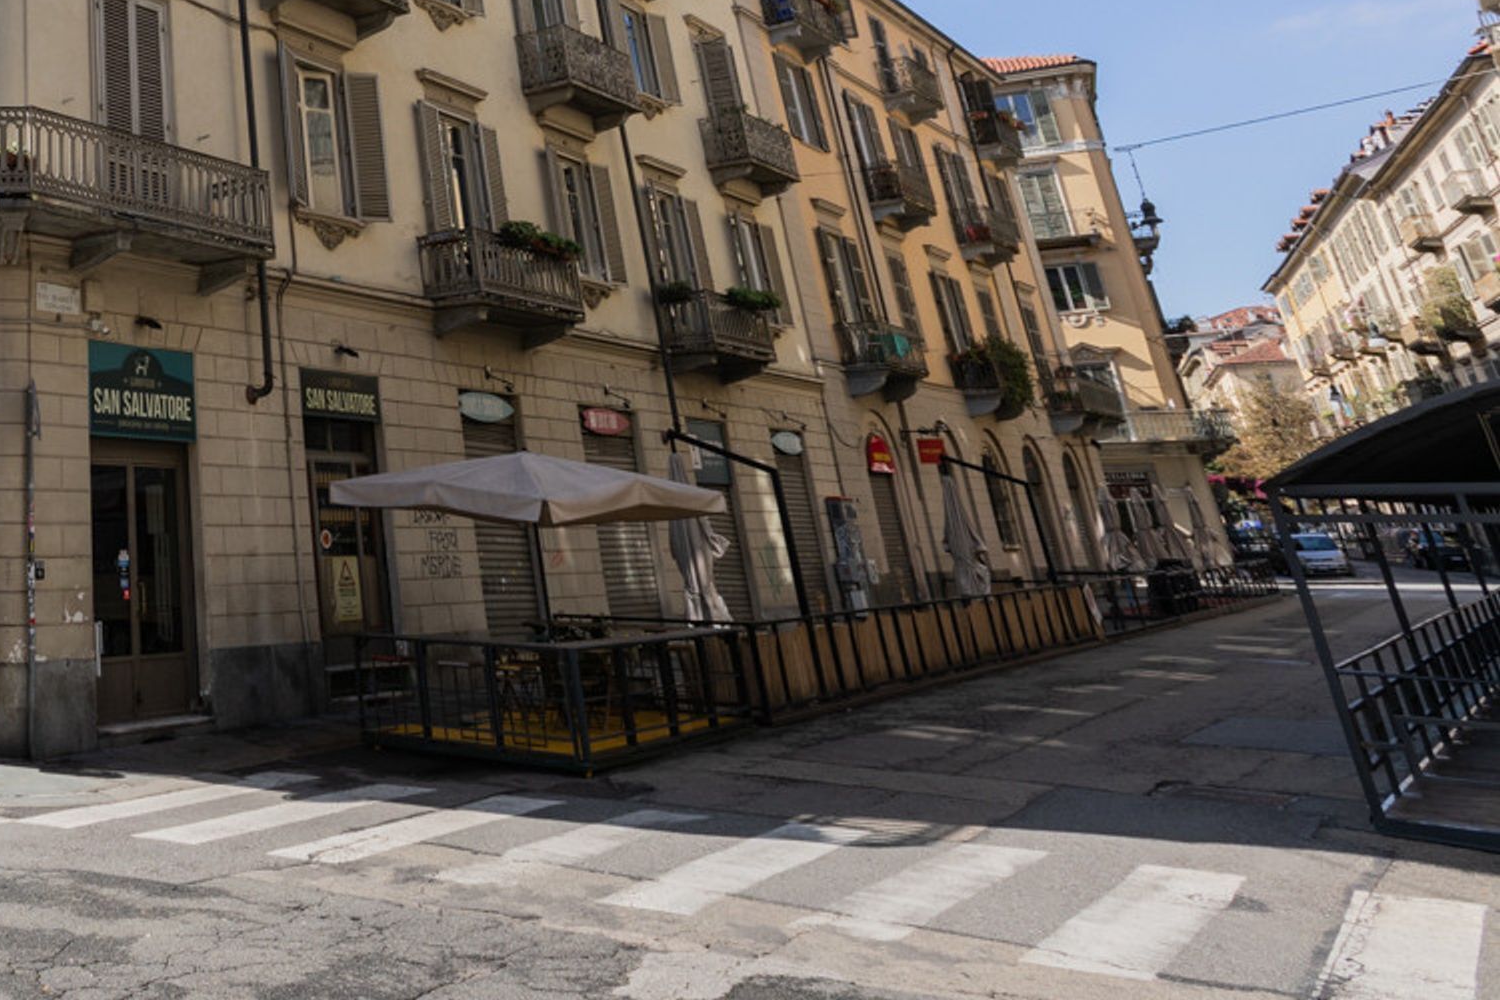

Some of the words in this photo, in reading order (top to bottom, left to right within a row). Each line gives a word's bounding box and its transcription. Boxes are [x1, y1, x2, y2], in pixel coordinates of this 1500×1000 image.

[93, 387, 121, 415] SAN
[122, 390, 191, 422] SALVATORE
[306, 387, 325, 410] SAN
[326, 389, 376, 416] SALVATORE
